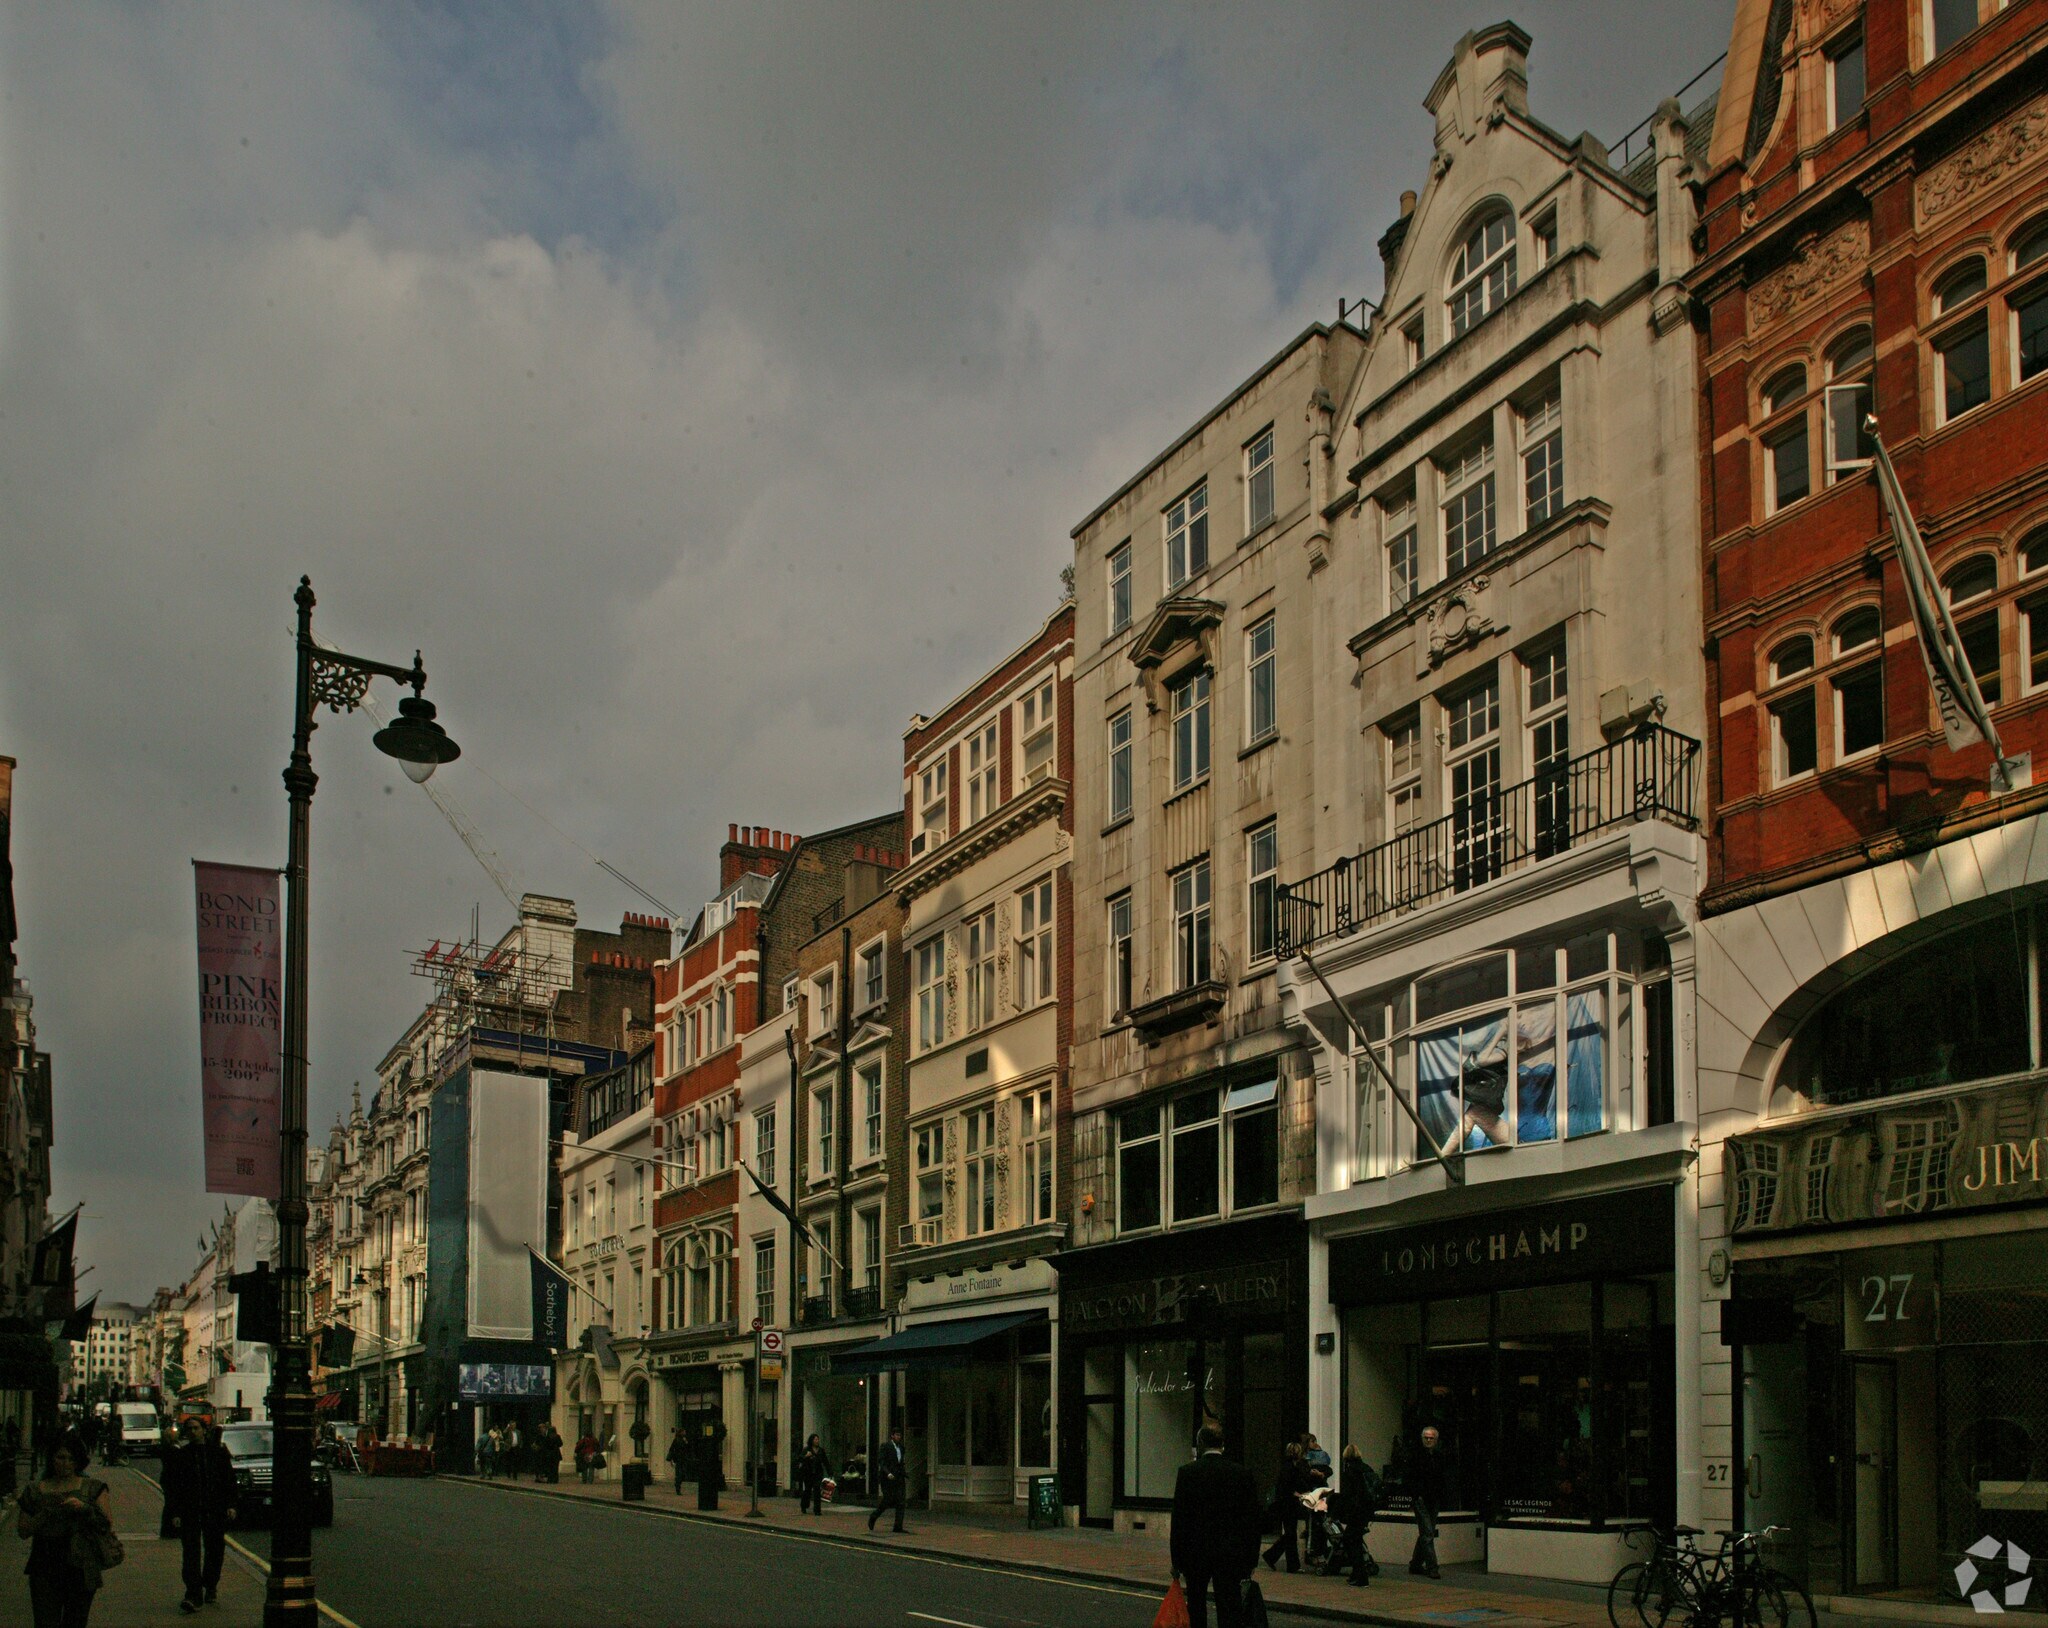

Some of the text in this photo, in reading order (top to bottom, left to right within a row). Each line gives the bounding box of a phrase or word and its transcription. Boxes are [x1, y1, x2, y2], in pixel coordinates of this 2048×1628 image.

[199, 891, 276, 916] BOND
[200, 912, 276, 934] STREET
[201, 973, 279, 1001] PINK
[202, 995, 279, 1015] RIBBON
[202, 1011, 280, 1031] PROJECT
[203, 1057, 281, 1075] 15-21 October
[223, 1069, 260, 1082] 2007
[236, 1168, 255, 1176] END
[1963, 1136, 2048, 1191] JIM
[1383, 1221, 1588, 1276] LONGCHAMP
[947, 1274, 1002, 1296] Anne Fontaine
[543, 1282, 558, 1336] Sotheby's
[1064, 1292, 1147, 1322] HALCYON
[1192, 1274, 1282, 1306] ALLERY
[1861, 1273, 1915, 1323] 27
[691, 1350, 710, 1363] GREEN
[1707, 1464, 1728, 1481] 27
[1524, 1499, 1553, 1507] LEGENDE
